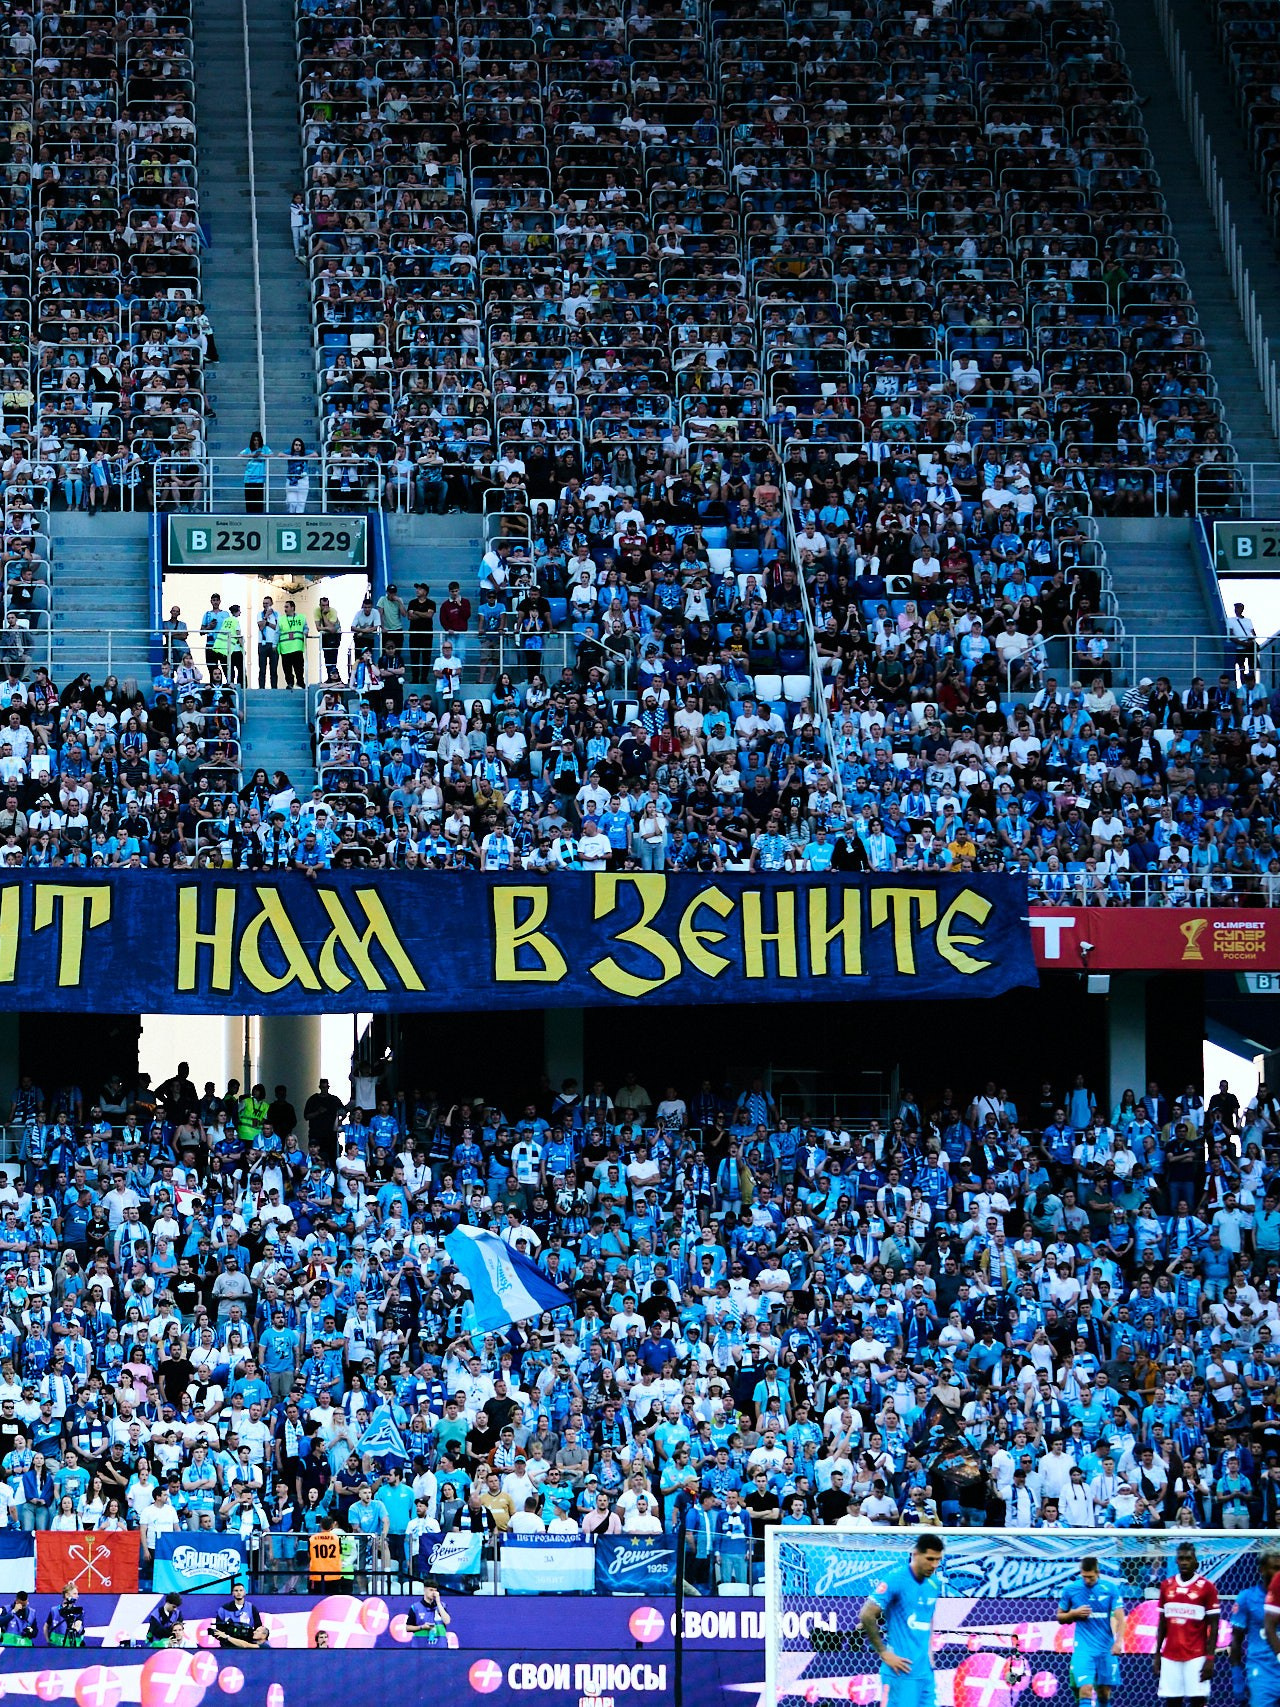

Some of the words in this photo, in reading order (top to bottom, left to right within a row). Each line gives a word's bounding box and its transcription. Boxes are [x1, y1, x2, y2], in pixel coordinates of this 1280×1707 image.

[191, 530, 207, 550] B
[216, 531, 261, 551] 230
[281, 530, 297, 551] B
[306, 531, 351, 551] 229
[1237, 537, 1253, 557] B
[1213, 921, 1266, 929] OLIMPBET
[176, 886, 427, 993] НАМ
[493, 886, 567, 983] В
[1213, 930, 1266, 942] СУПЕР
[1213, 941, 1266, 952] КУБОК
[313, 1543, 337, 1559] 102
[608, 1546, 669, 1575] Зенит
[646, 1563, 669, 1573] 1925
[507, 1663, 570, 1690] СВОИ
[574, 1663, 667, 1691] ПЛЮСЫ
